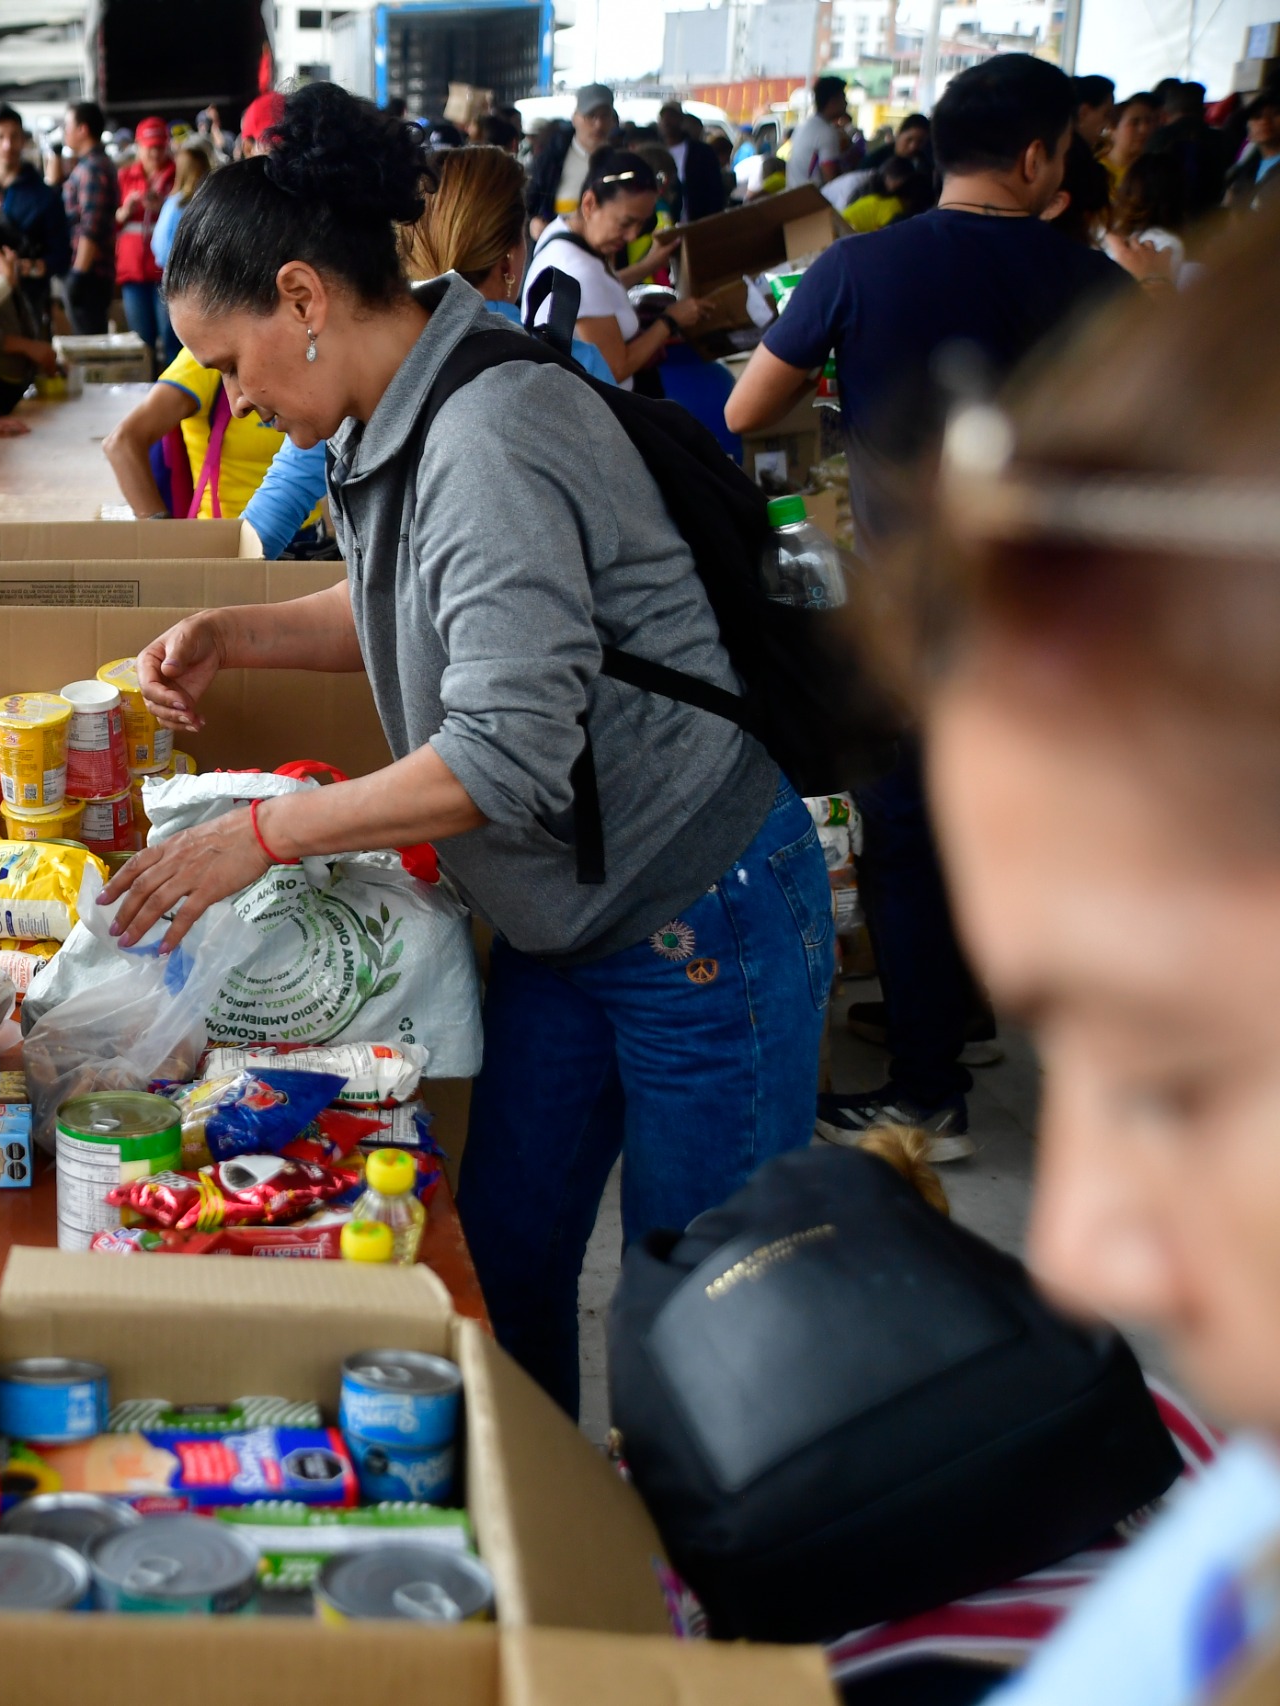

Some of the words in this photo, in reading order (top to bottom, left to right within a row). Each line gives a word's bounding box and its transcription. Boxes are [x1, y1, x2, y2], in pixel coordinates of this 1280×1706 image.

[225, 1010, 290, 1026] AMBIENTE
[204, 1018, 268, 1042] ECONÓM
[279, 1021, 315, 1040] VIDA
